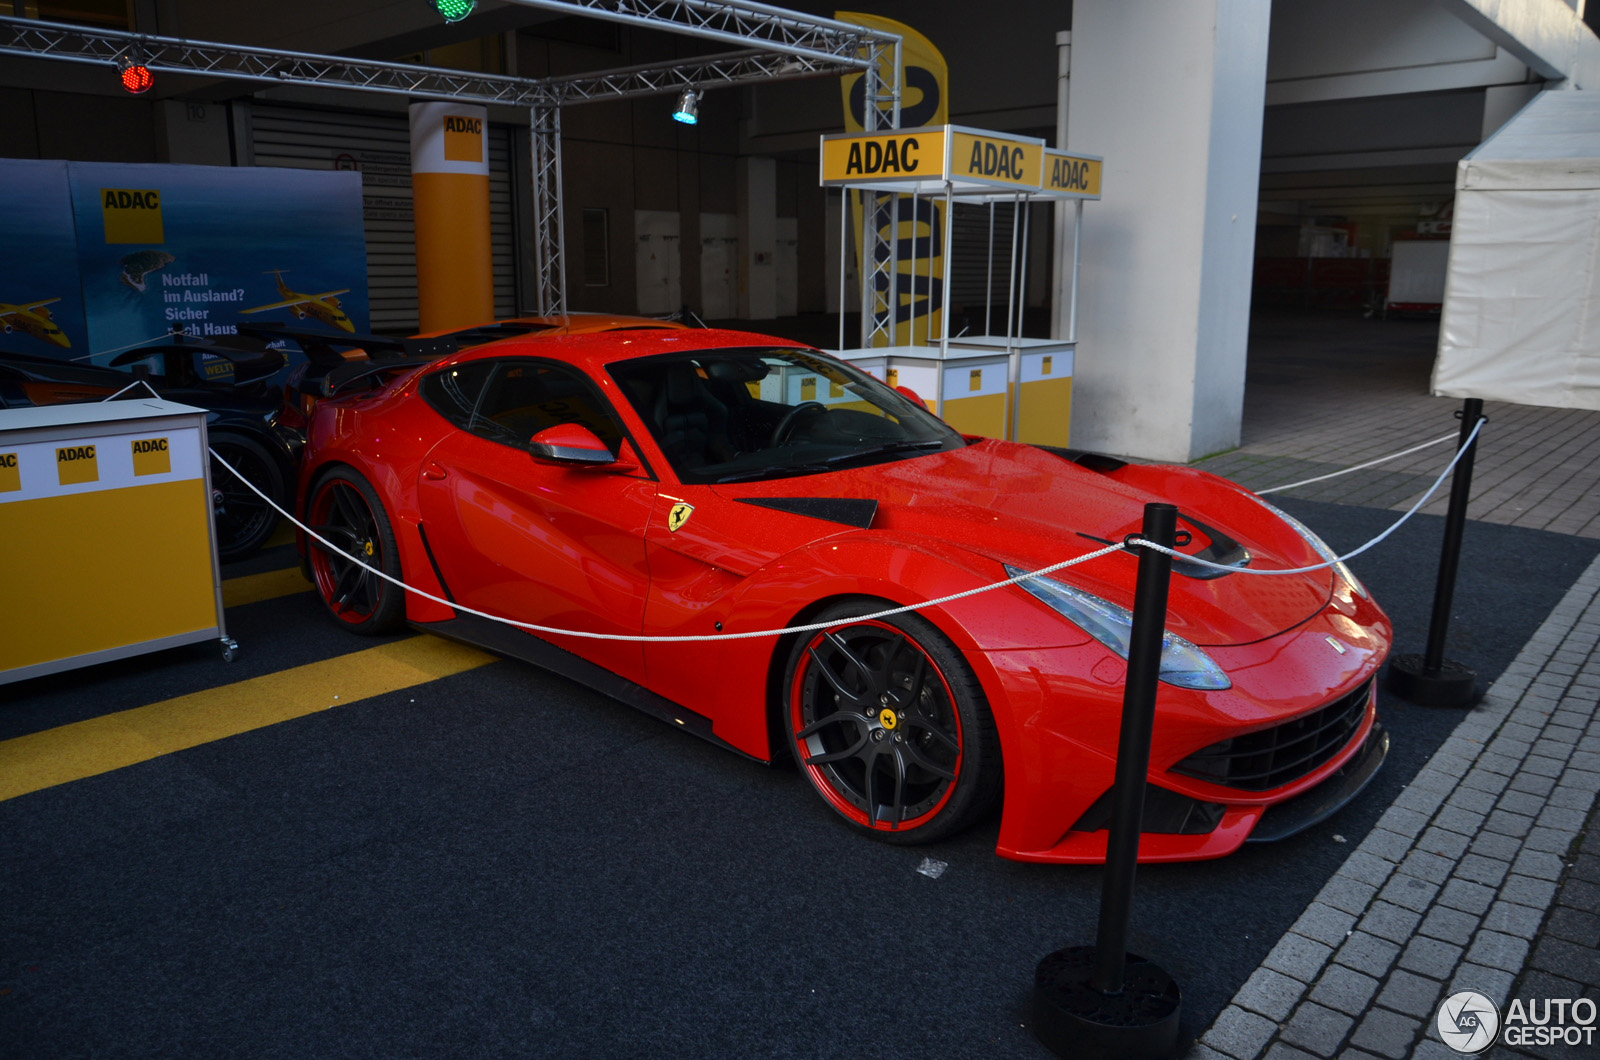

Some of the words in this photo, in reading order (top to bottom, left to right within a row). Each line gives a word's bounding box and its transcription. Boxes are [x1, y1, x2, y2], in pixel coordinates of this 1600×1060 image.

[446, 118, 482, 134] ADAC
[846, 138, 919, 175] ADAC
[969, 140, 1024, 180] ADAC
[1051, 158, 1089, 190] ADAC
[105, 191, 158, 209] ADAC
[162, 273, 208, 287] Notfall
[163, 290, 181, 303] im
[184, 289, 245, 302] Ausland?
[165, 307, 209, 320] Sicher
[204, 323, 238, 335] Haus
[58, 446, 95, 462] ADAC
[133, 439, 168, 454] ADAC
